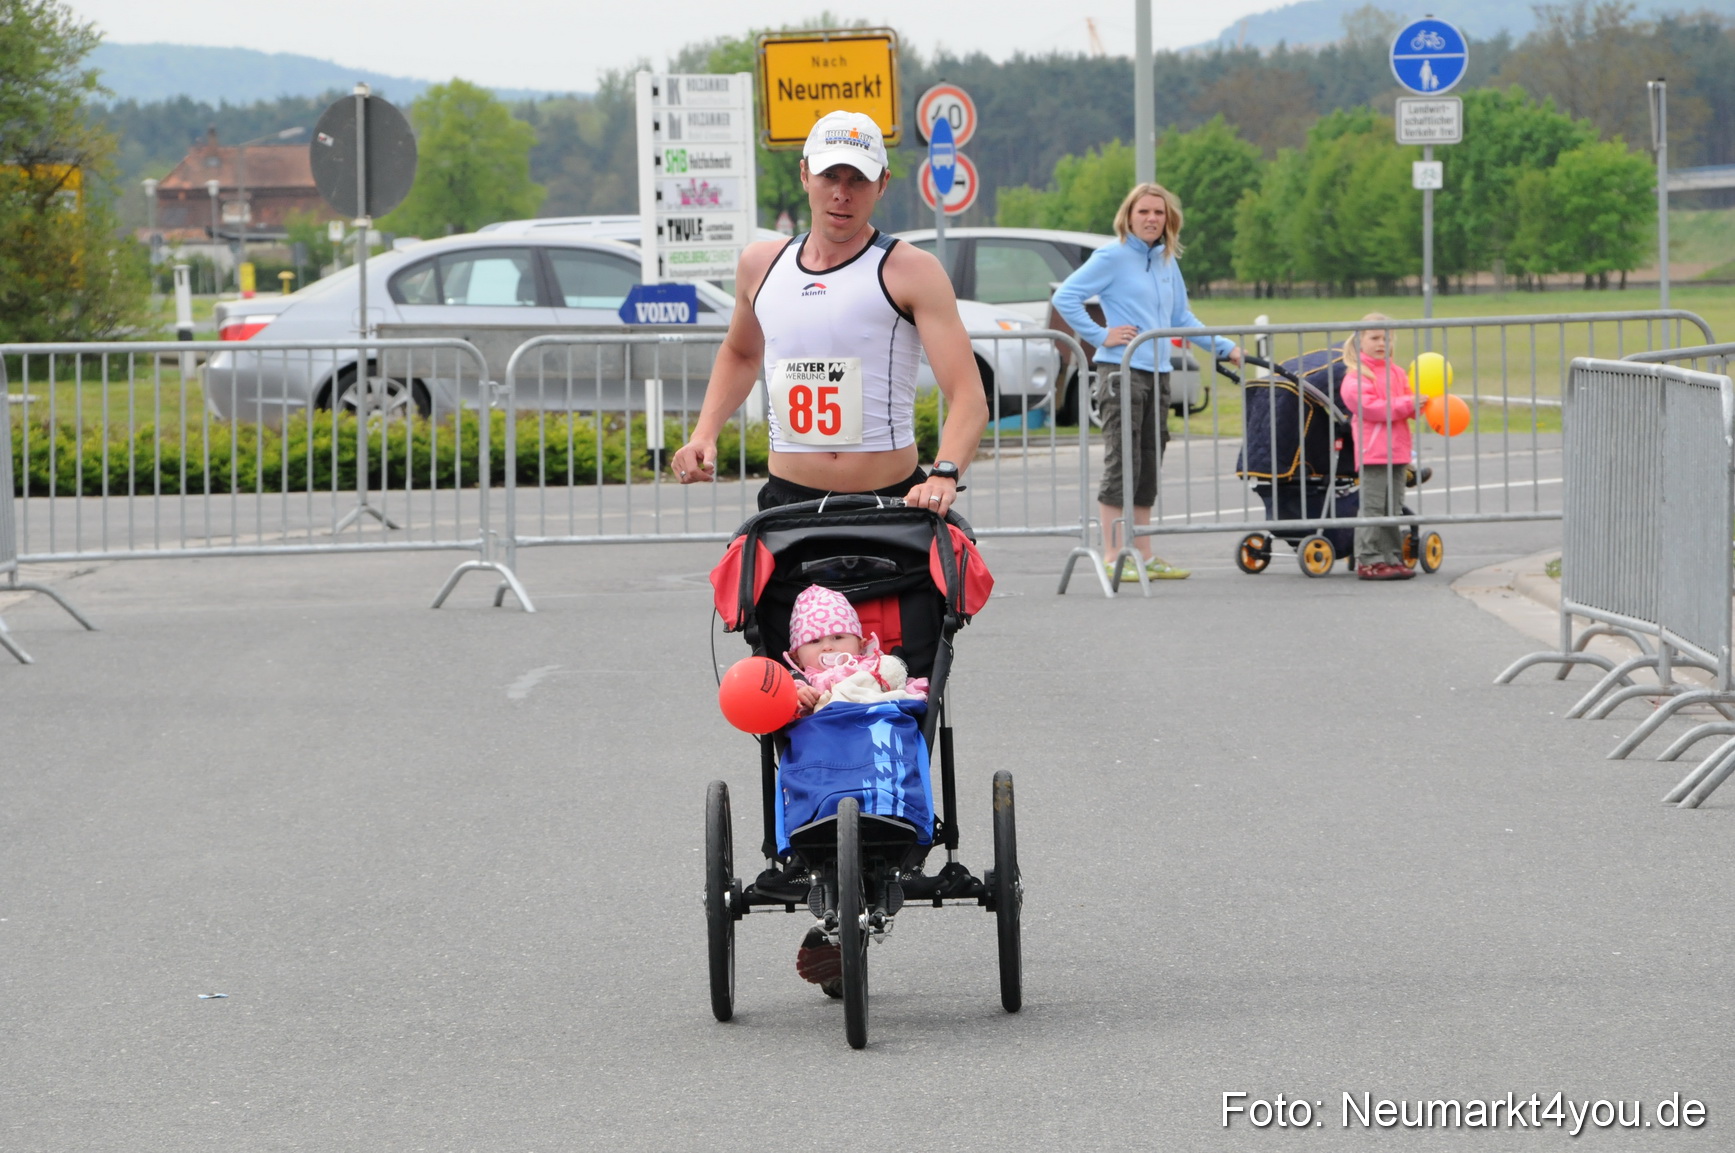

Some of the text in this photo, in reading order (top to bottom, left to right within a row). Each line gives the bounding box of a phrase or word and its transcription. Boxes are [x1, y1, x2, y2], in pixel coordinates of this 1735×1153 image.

[811, 56, 848, 68] Nach
[777, 74, 883, 101] Neumarkt
[1408, 104, 1451, 114] Landwirt-
[667, 218, 703, 242] THULE
[634, 301, 690, 323] VOLVO
[786, 362, 826, 373] MEYER
[785, 372, 826, 381] WERBUNG
[788, 384, 841, 436] 85
